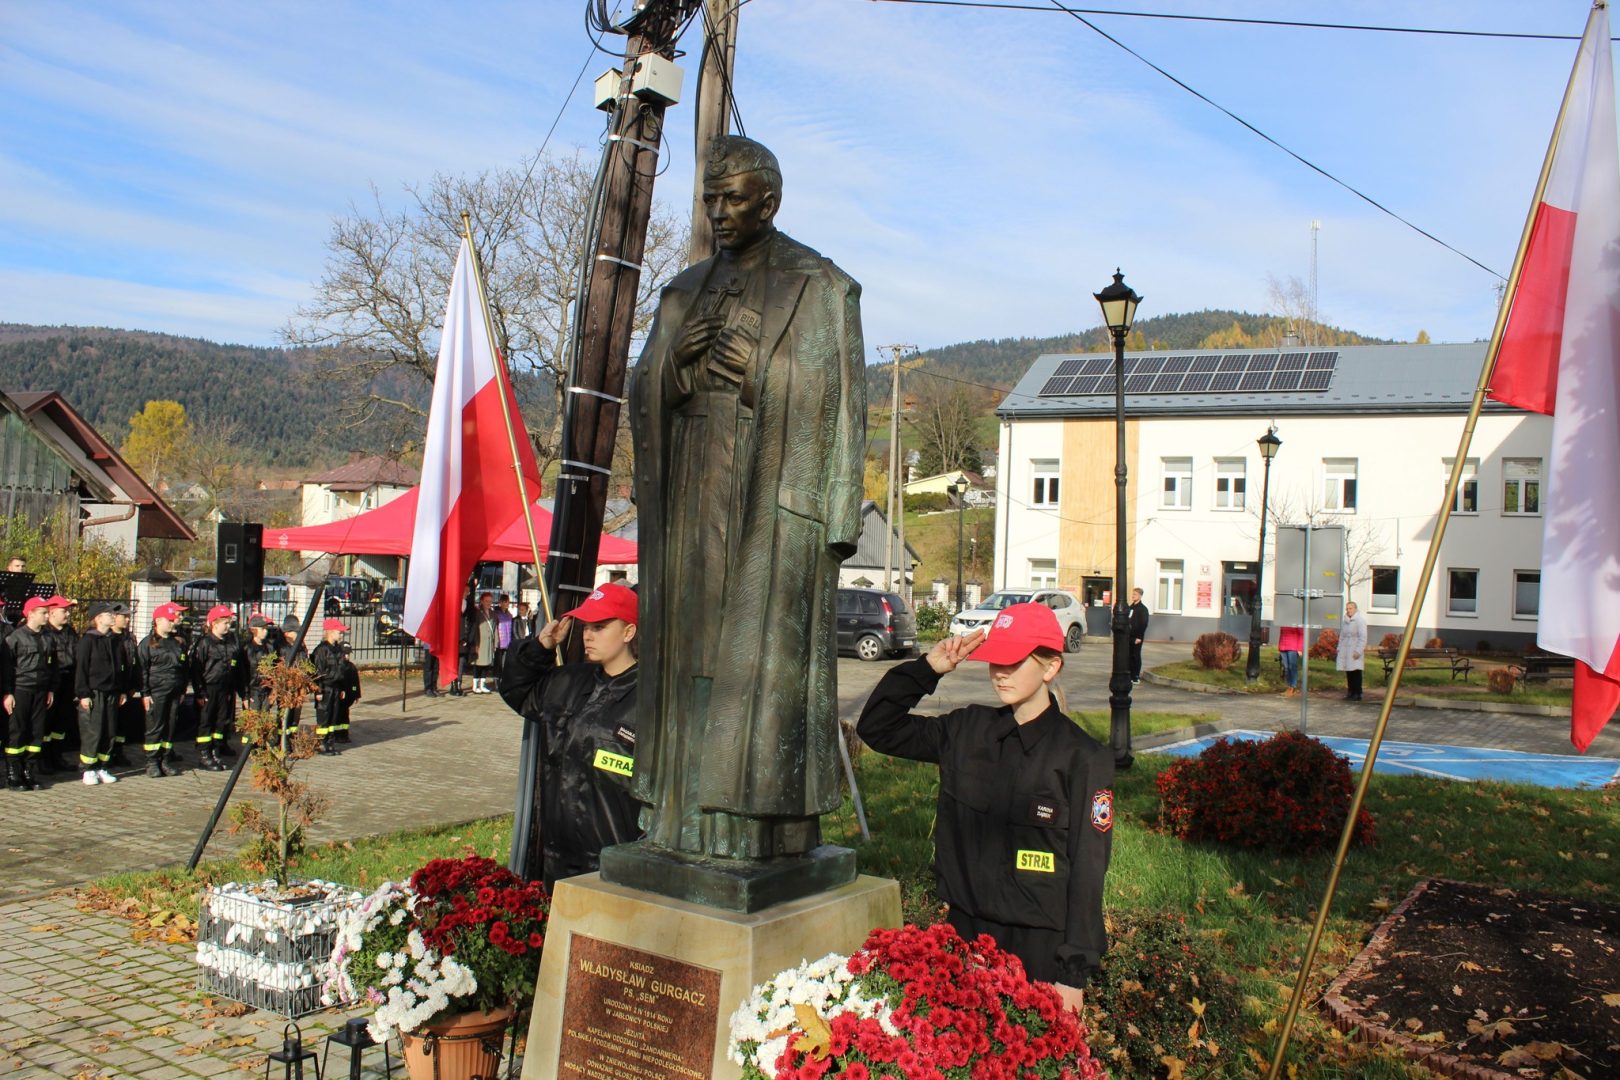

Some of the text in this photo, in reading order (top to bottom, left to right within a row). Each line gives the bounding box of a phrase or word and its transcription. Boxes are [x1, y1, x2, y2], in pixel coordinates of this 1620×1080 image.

[579, 959, 705, 1006] WŁADYSŁAW GURGACZ
[623, 986, 635, 998] PS.
[657, 1013, 673, 1024] ROKU
[642, 1019, 668, 1032] POLSKIEJ
[567, 1029, 591, 1042] POLSKIEJ
